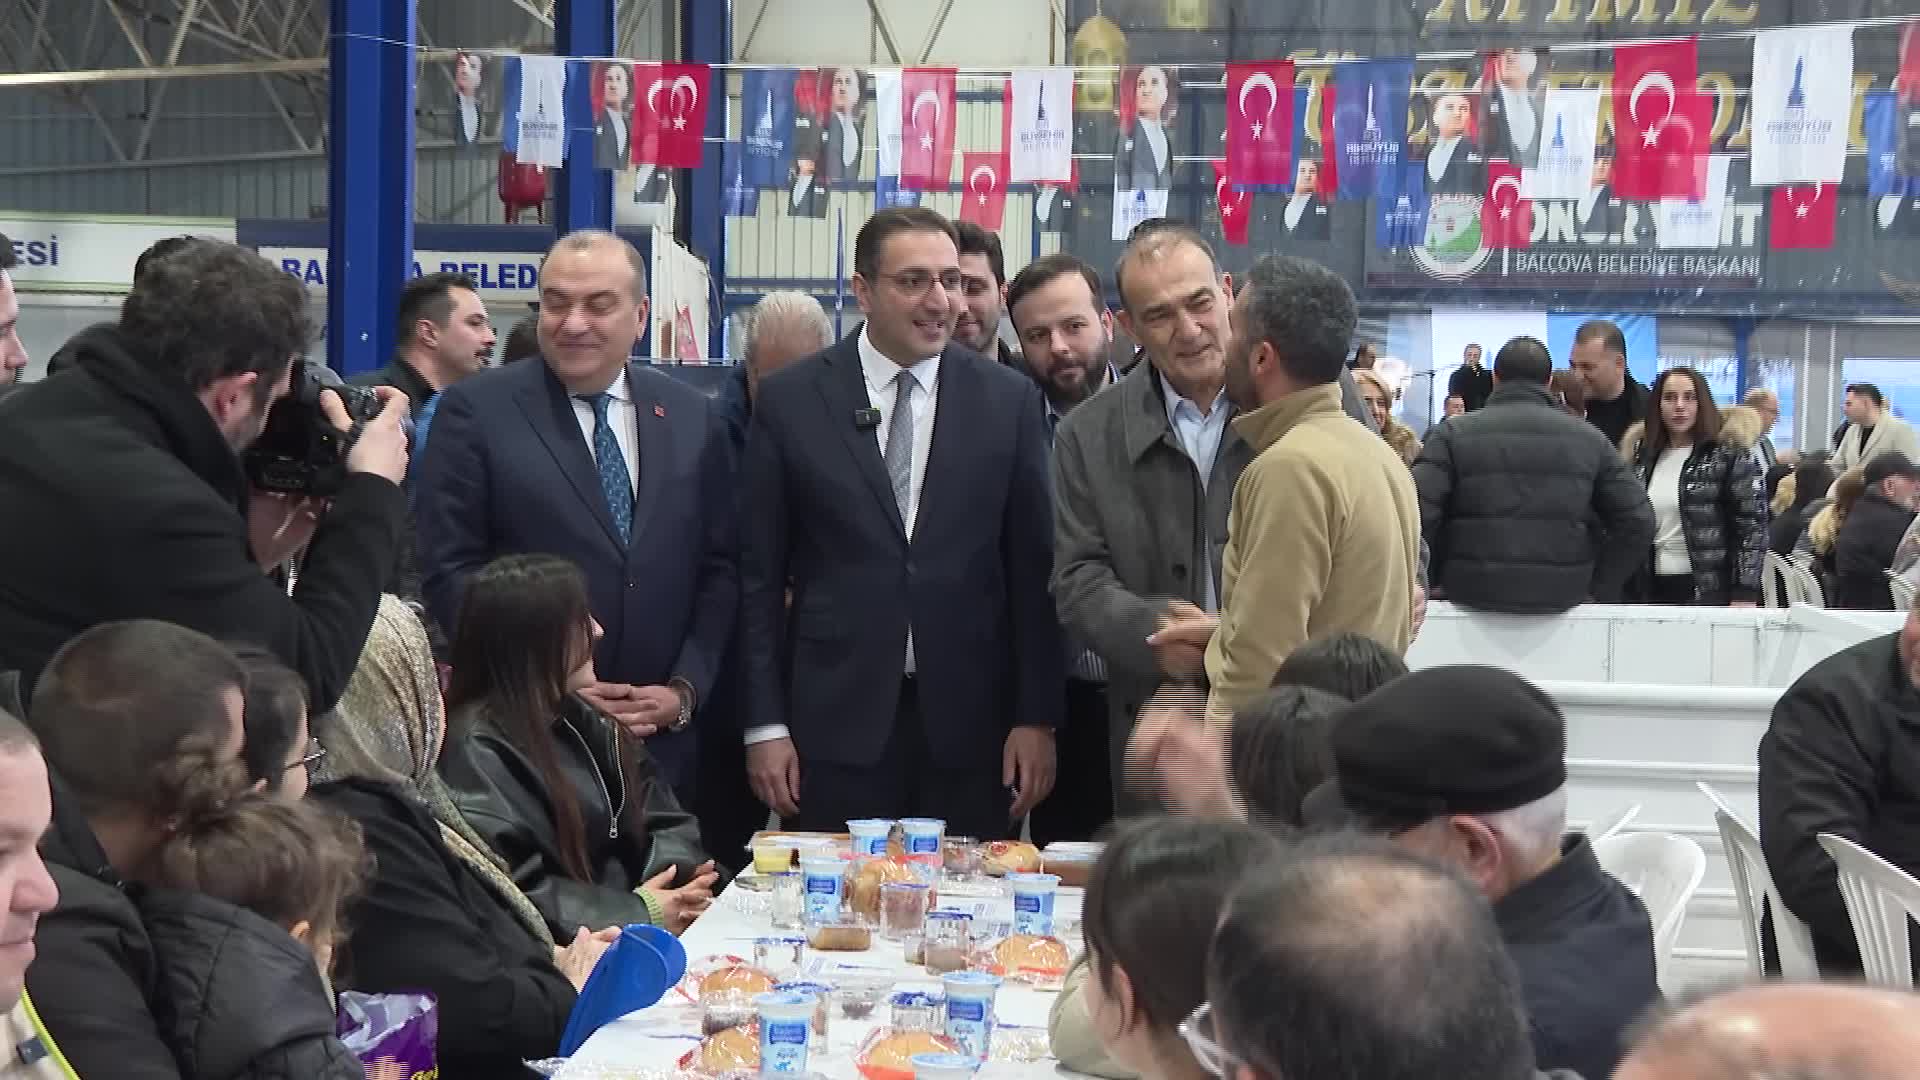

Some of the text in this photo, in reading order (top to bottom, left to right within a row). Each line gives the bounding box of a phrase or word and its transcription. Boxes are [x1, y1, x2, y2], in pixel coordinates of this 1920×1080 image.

[1515, 250, 1761, 279] BALÇOVA BELEDİYE BAŞKANI
